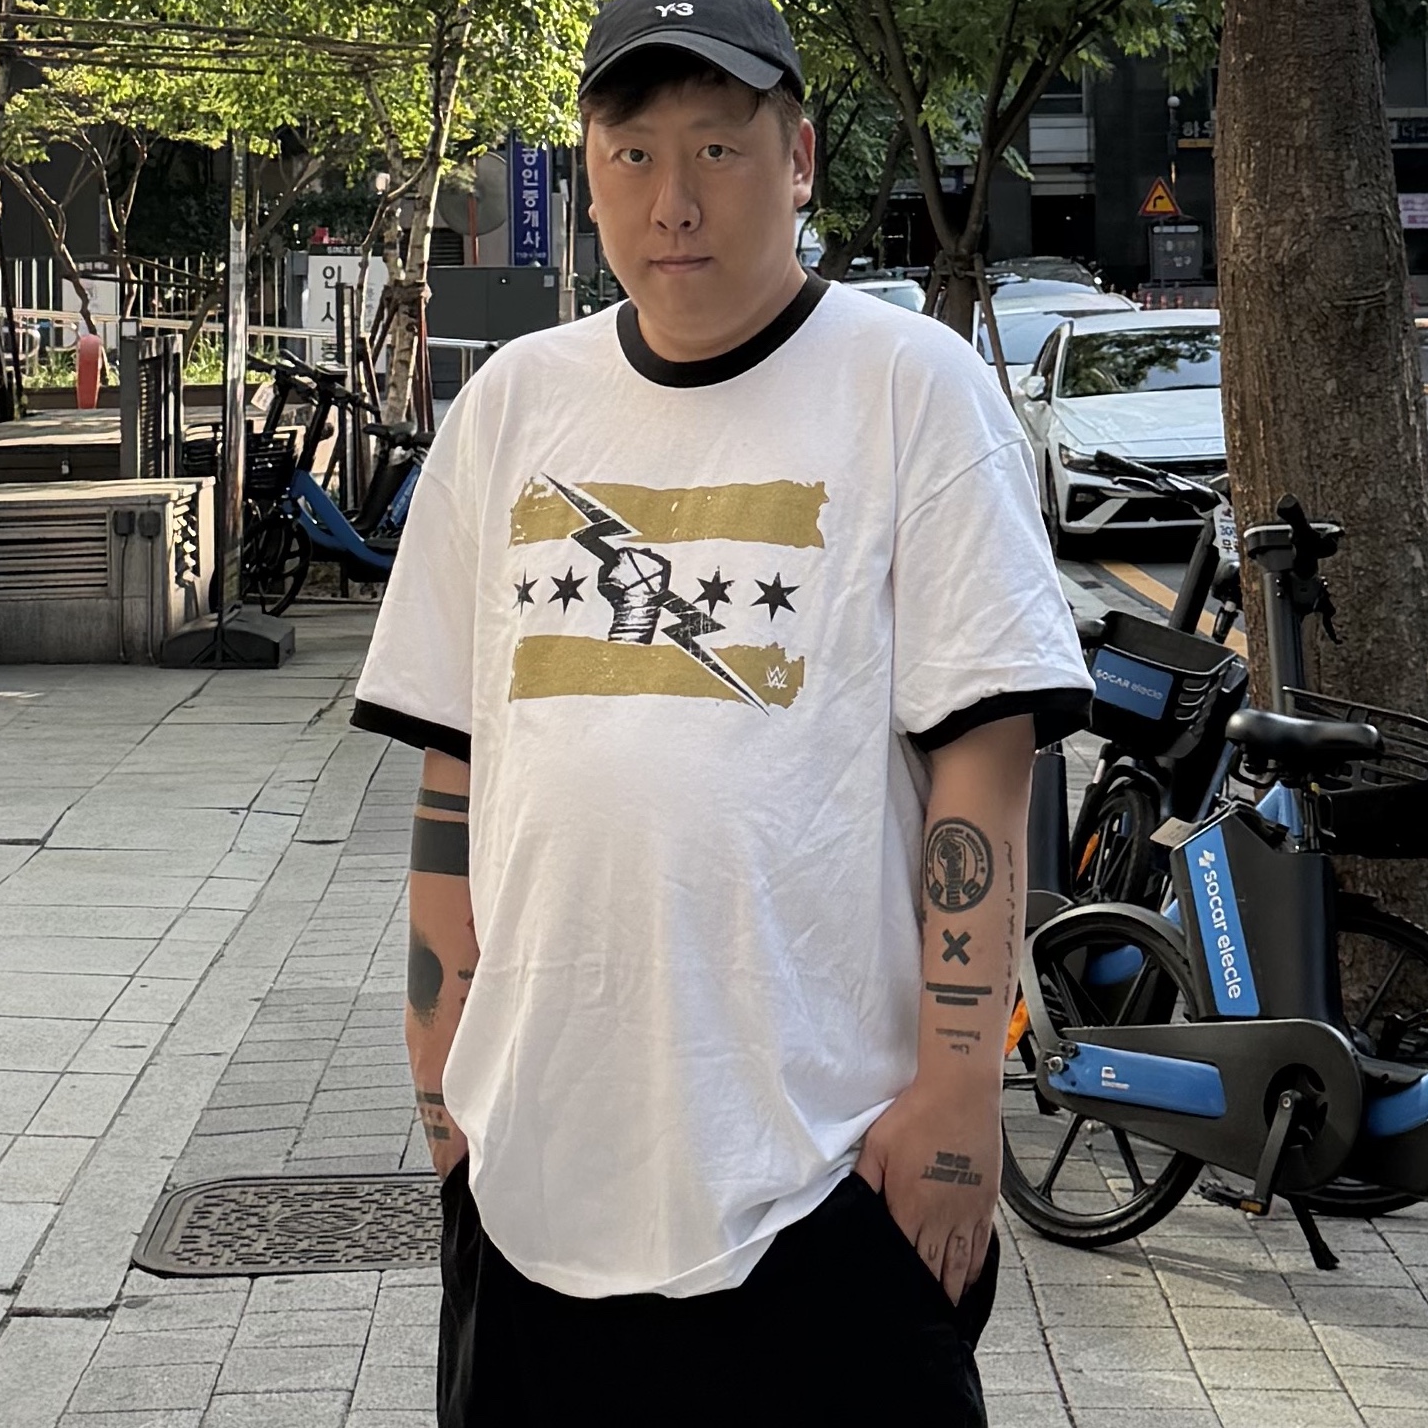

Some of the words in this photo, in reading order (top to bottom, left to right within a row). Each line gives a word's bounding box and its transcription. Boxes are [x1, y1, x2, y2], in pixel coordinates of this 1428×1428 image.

[654, 2, 694, 18] Y-3
[1095, 668, 1131, 689] SOCAR
[1203, 869, 1228, 932] socar
[1217, 934, 1242, 1000] elecle
